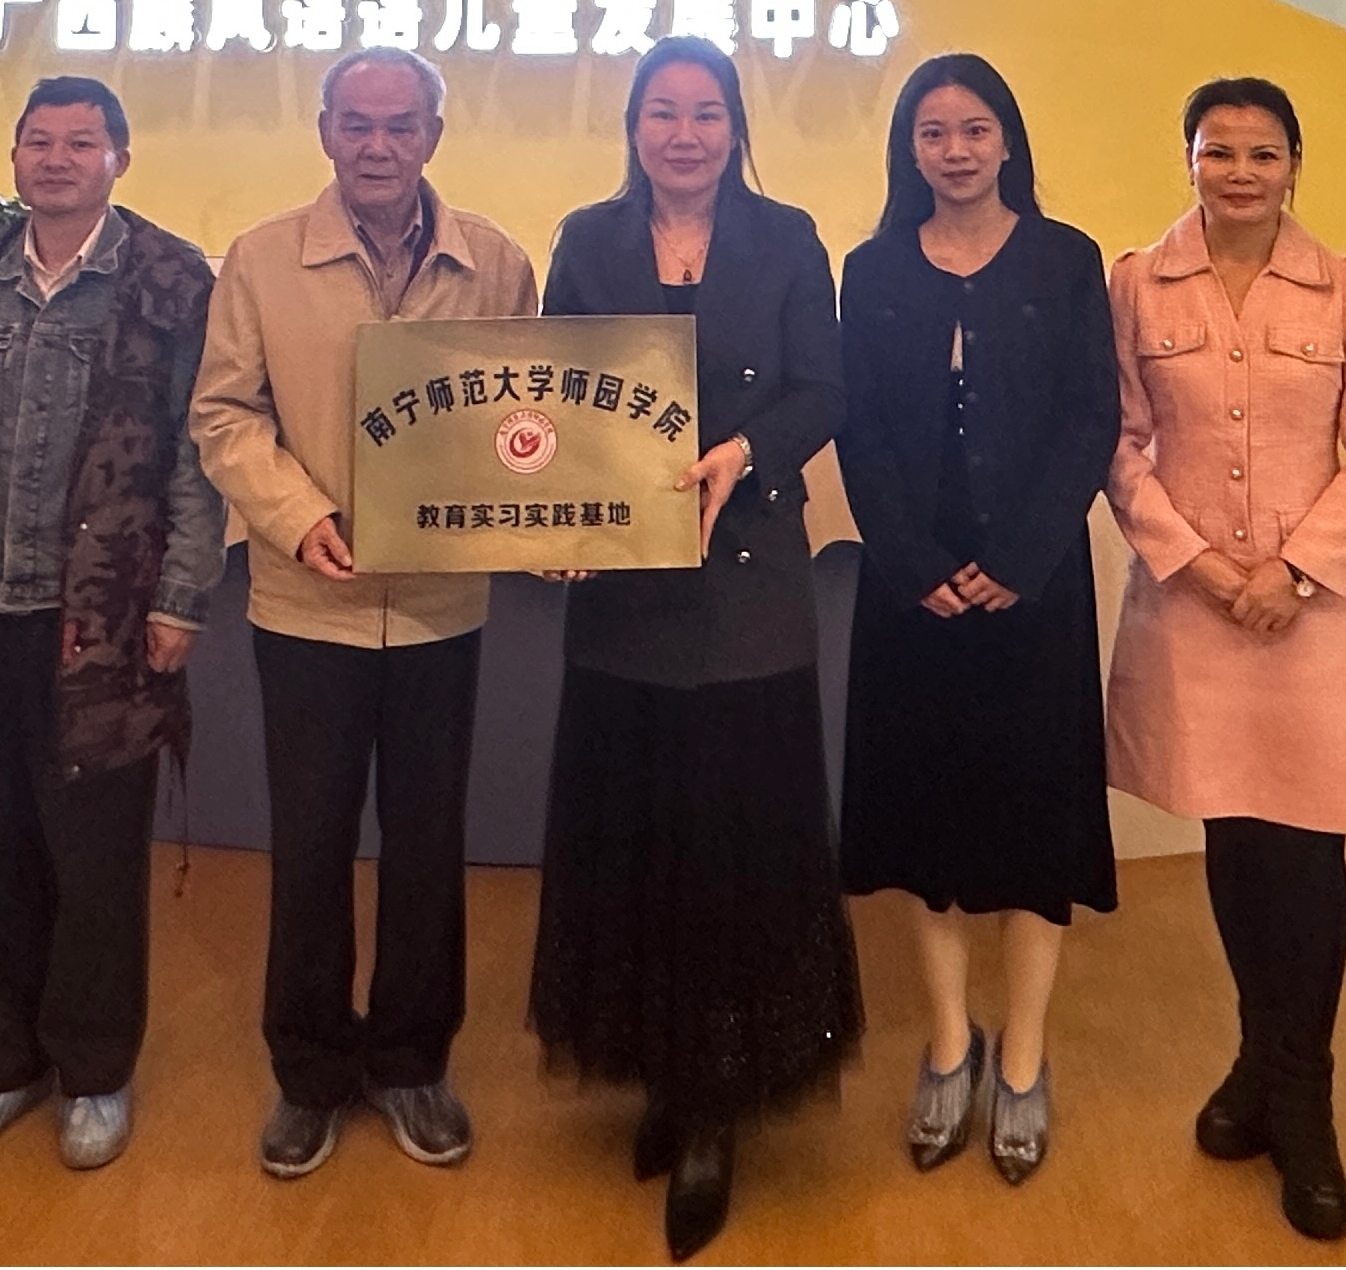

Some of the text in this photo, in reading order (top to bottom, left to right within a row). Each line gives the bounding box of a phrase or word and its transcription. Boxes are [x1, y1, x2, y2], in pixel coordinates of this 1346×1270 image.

[360, 365, 691, 447] 南宁师范大学师园学院
[416, 501, 631, 529] 教育实习实践基地
